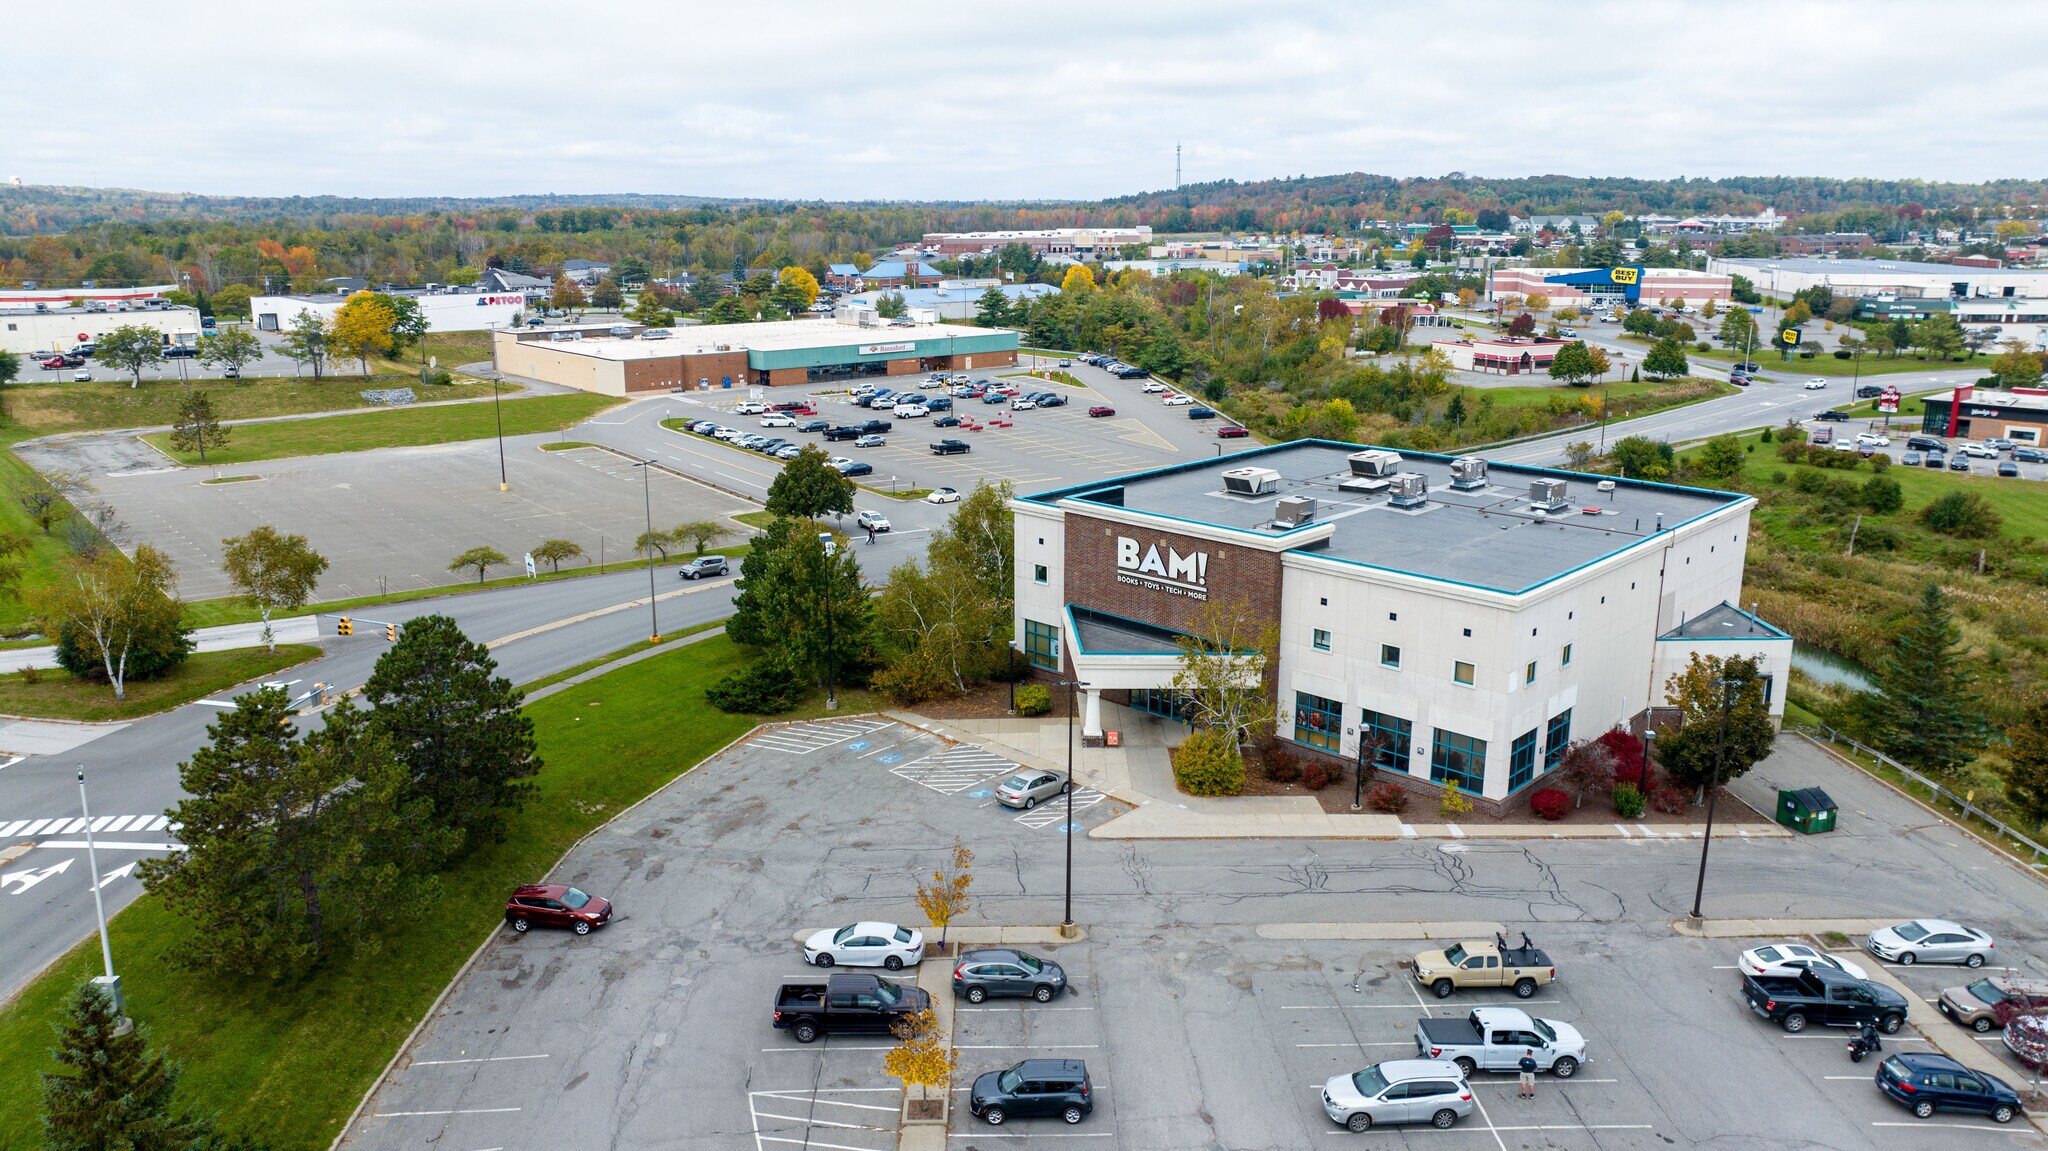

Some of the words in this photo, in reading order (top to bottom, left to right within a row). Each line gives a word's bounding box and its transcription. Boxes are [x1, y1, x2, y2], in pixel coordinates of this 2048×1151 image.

[489, 295, 523, 305] PETCO
[1117, 536, 1208, 585] BAM!
[1117, 576, 1139, 586] BOOKS
[1144, 581, 1160, 591] TOYS
[1165, 586, 1182, 595] TECH
[1187, 591, 1207, 601] MORE
